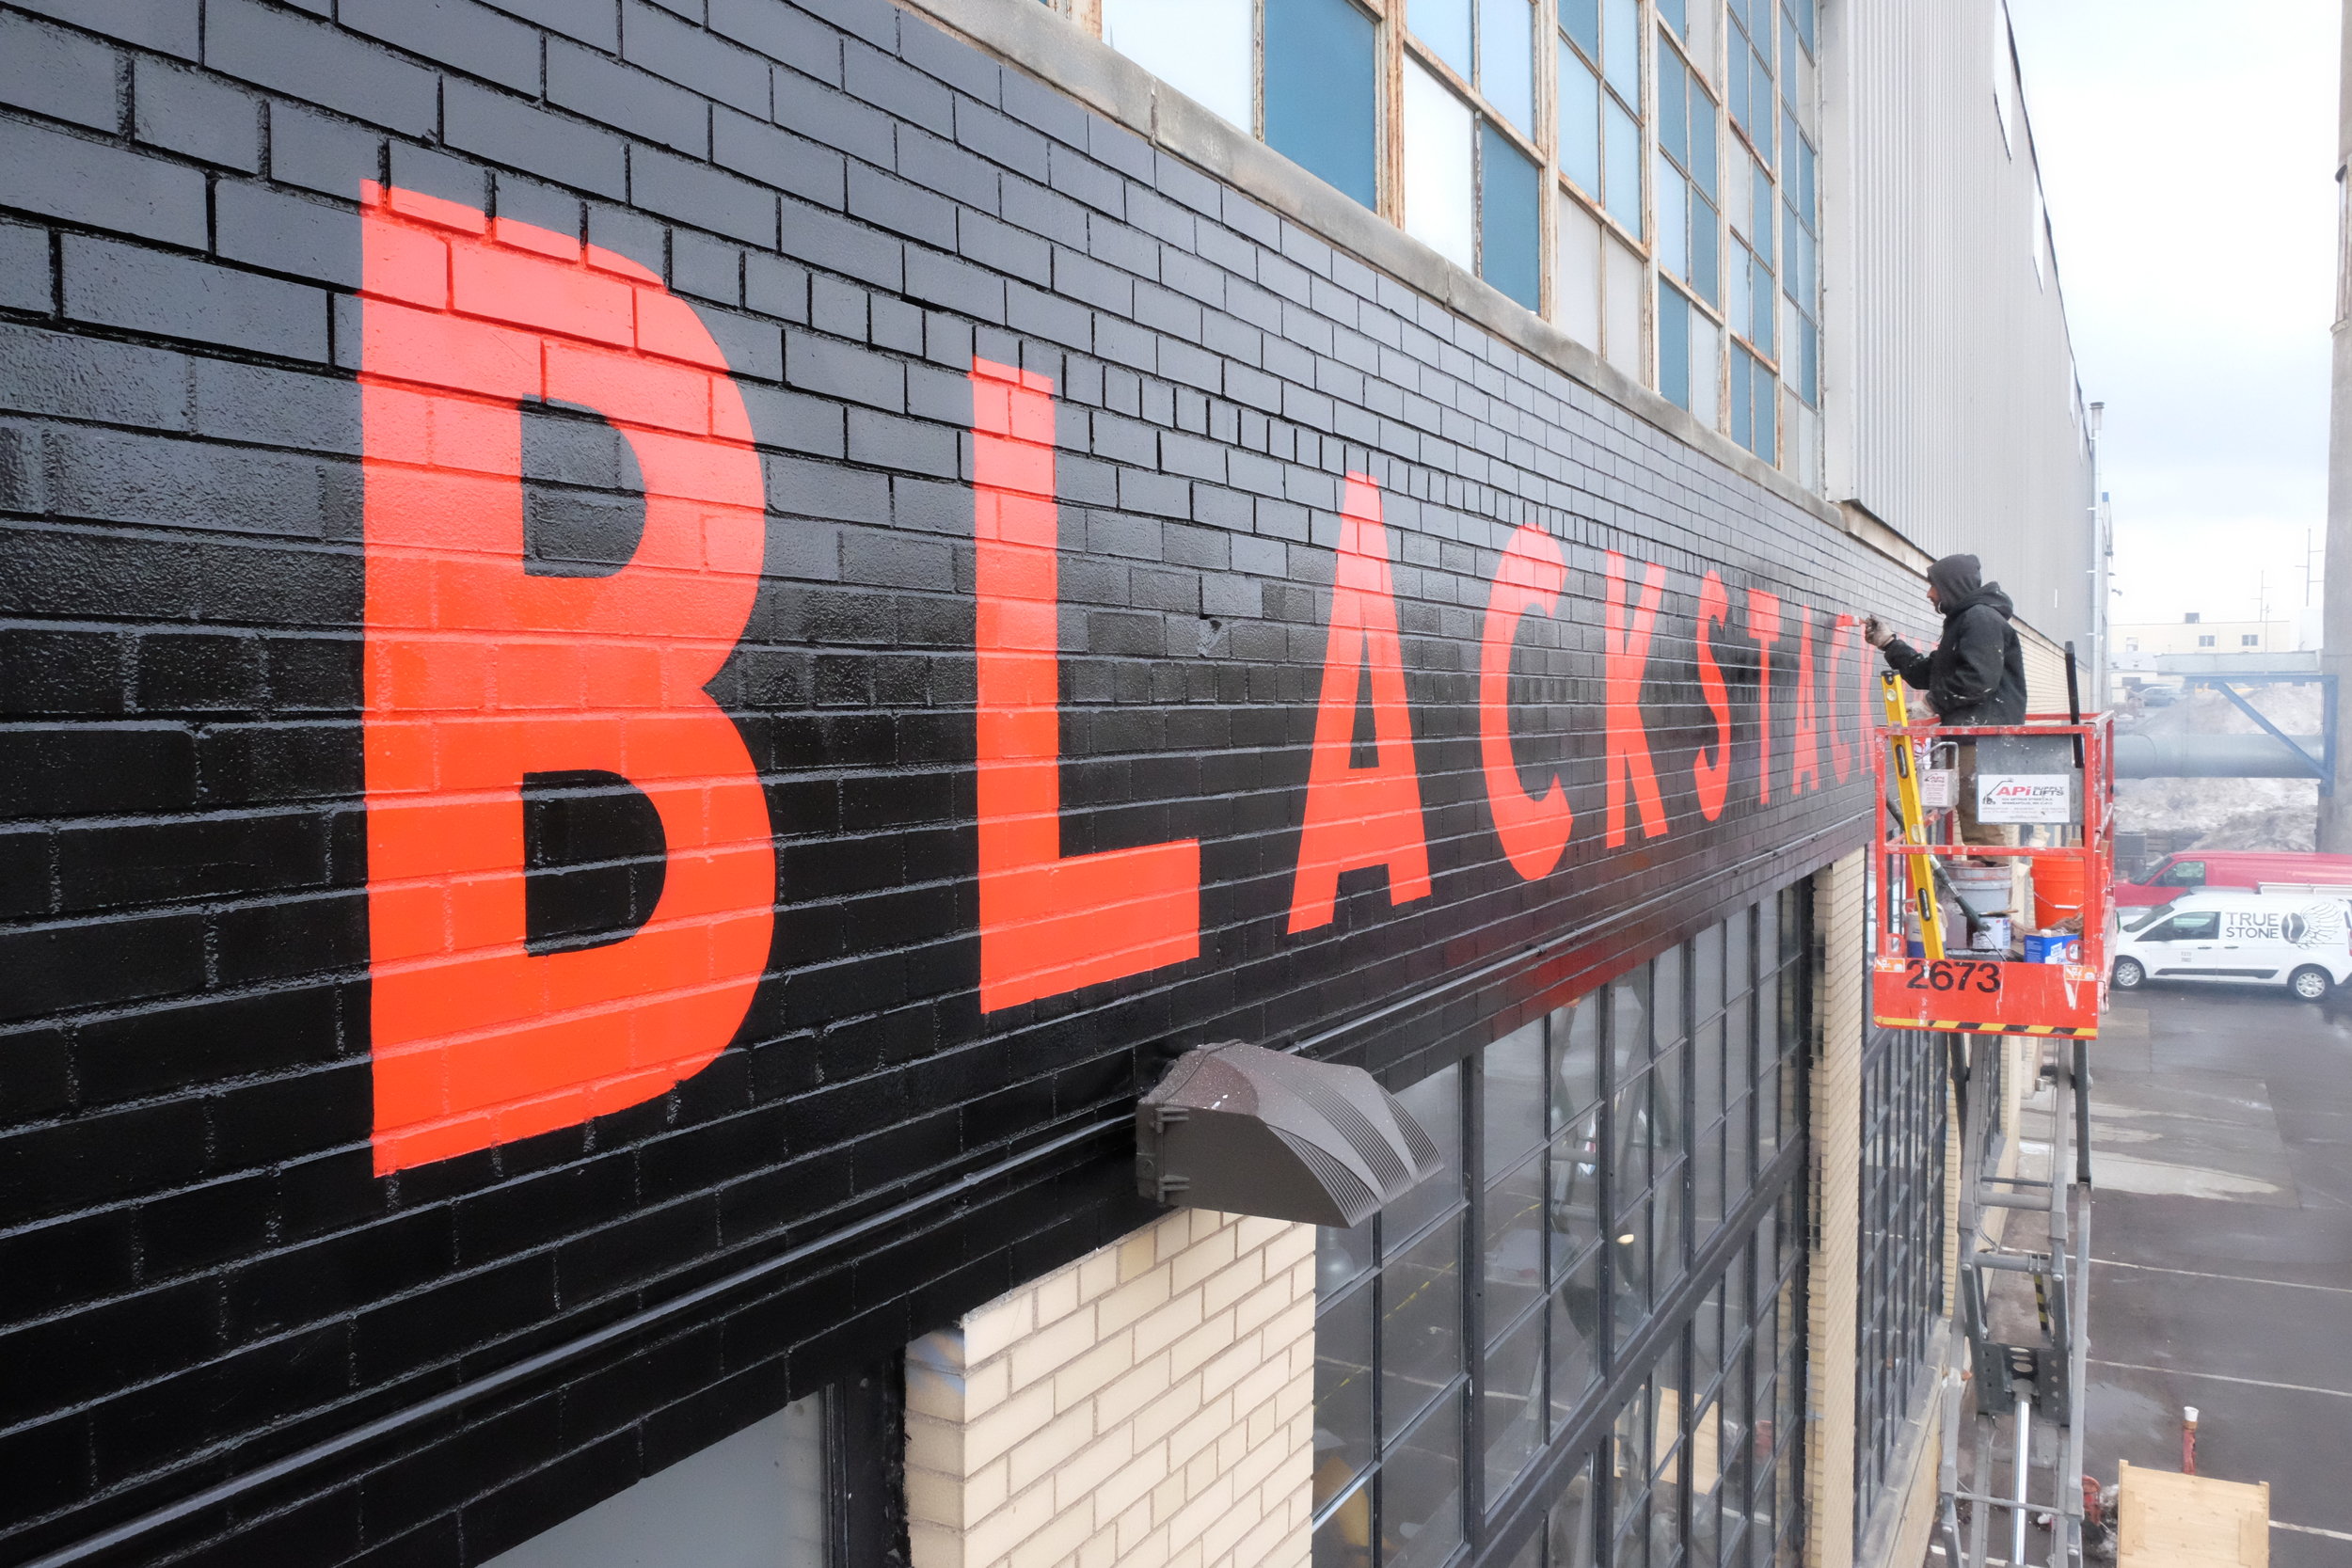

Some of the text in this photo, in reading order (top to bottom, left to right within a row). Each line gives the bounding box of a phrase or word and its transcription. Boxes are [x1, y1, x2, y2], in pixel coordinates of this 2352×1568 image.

[358, 178, 1876, 1178] BLACKSTACK
[2226, 911, 2279, 927] TRUE
[2226, 927, 2279, 939] STONE
[1906, 959, 2001, 993] 2673
